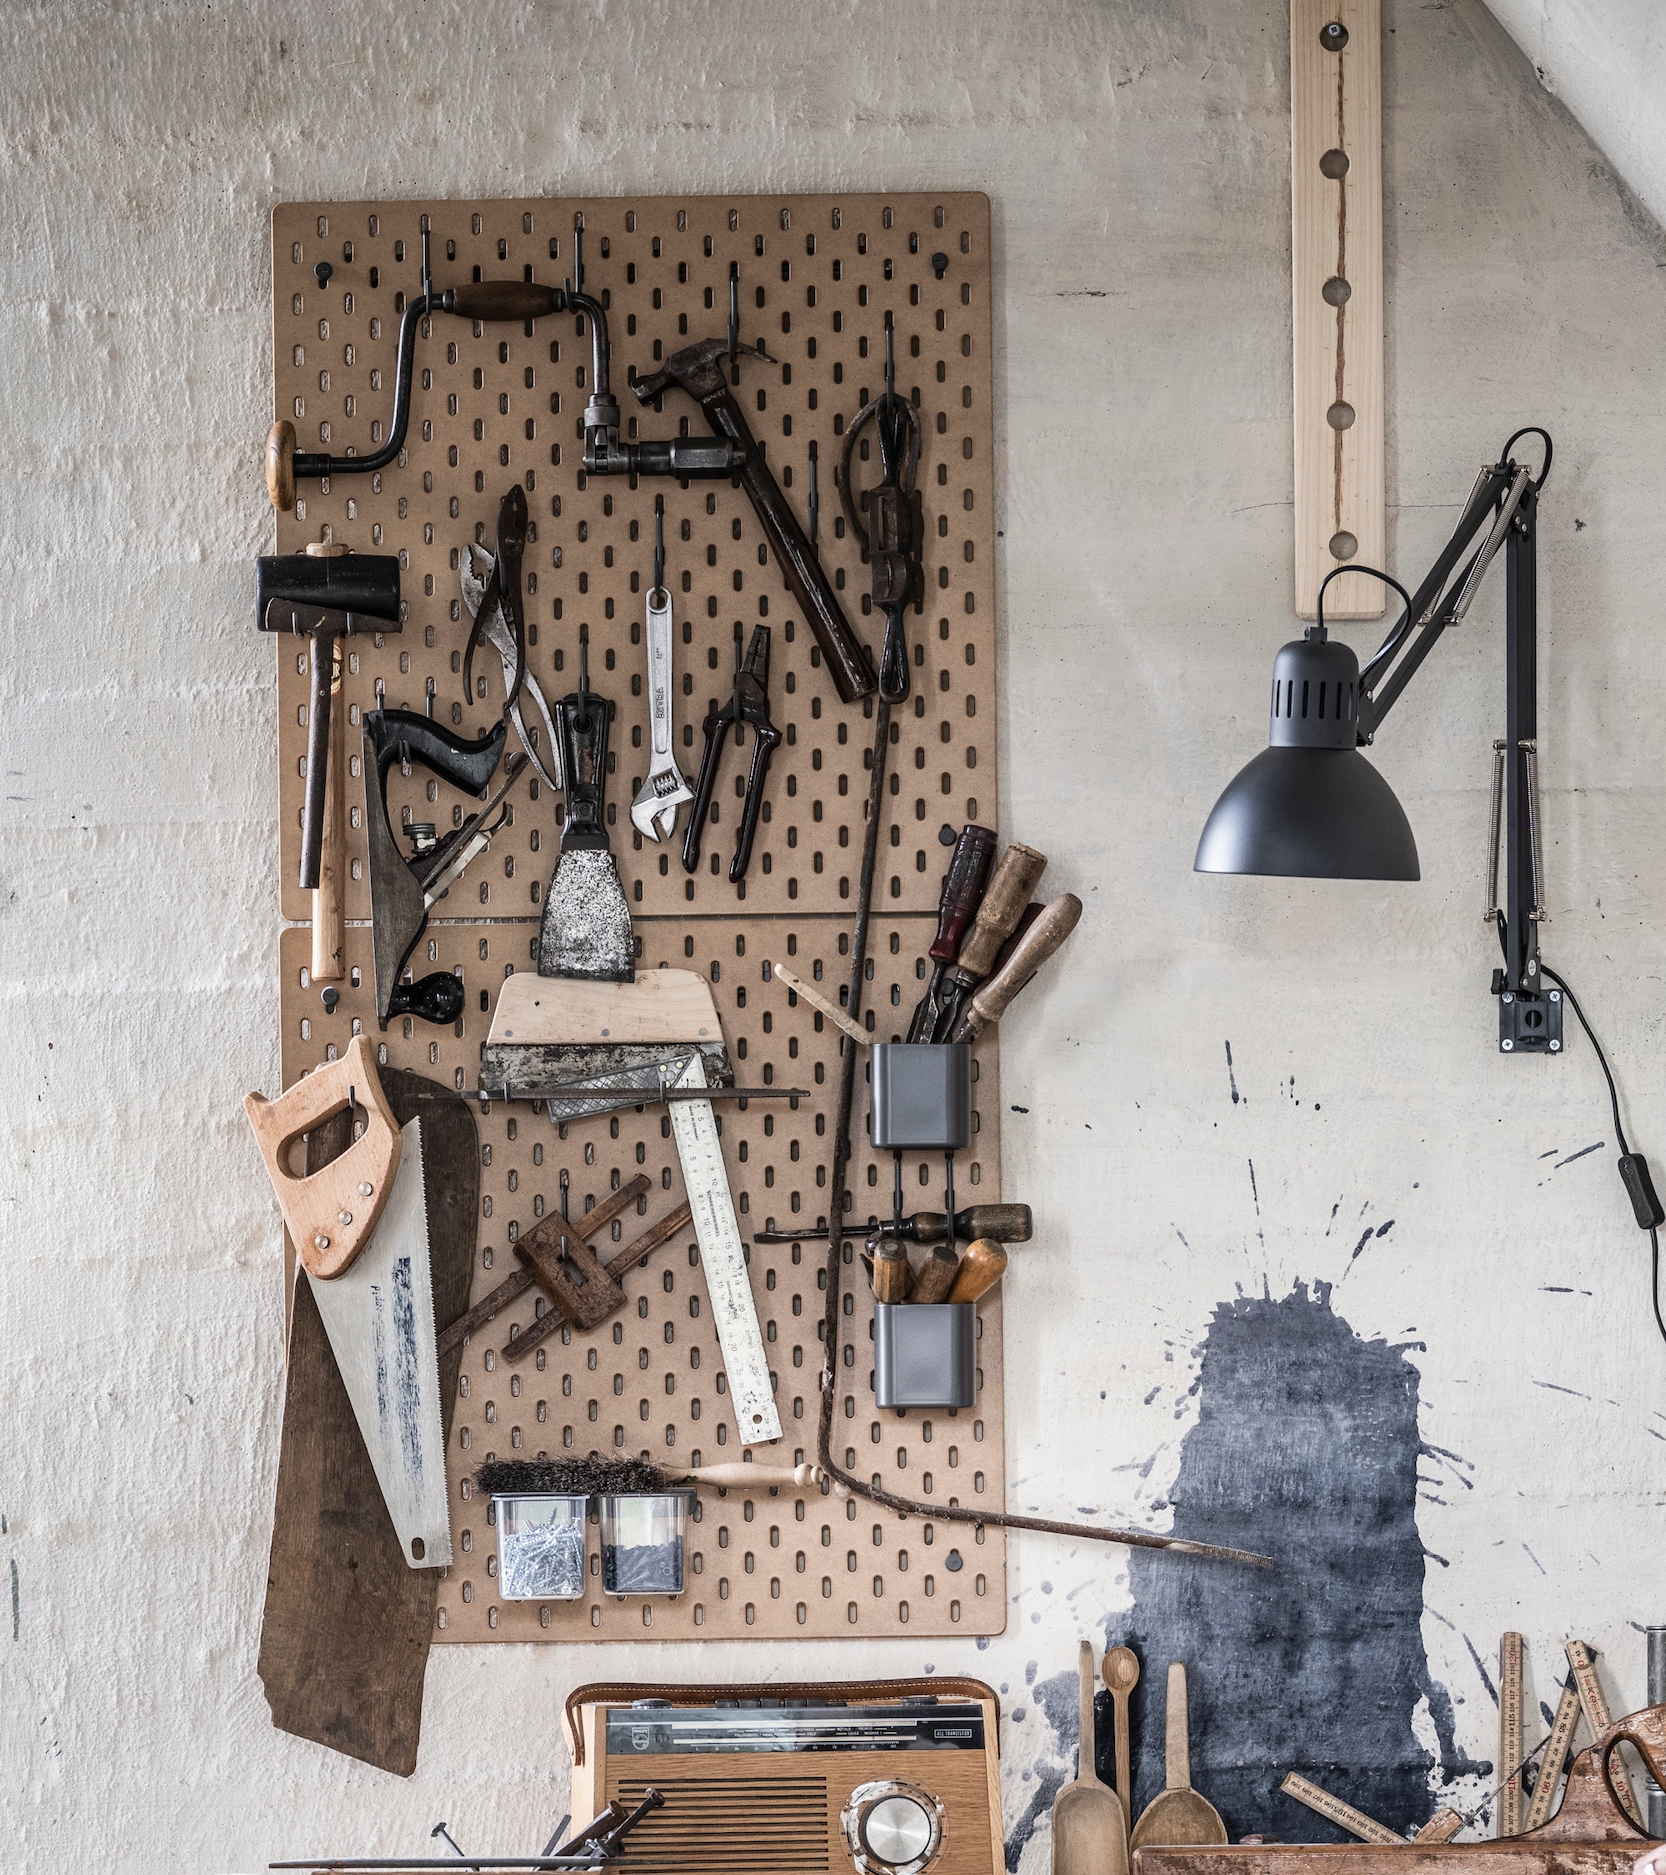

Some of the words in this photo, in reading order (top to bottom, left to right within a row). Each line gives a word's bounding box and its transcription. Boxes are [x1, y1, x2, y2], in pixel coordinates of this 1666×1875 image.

[655, 686, 664, 719] EXTRA
[704, 1217, 710, 1226] 10
[711, 1178, 718, 1186] 10
[738, 1303, 746, 1312] 20
[1509, 1650, 1517, 1666] 120
[1566, 1700, 1573, 1709] 83
[1563, 1712, 1569, 1720] 84
[1559, 1722, 1567, 1733] 85
[1555, 1736, 1562, 1744] 86
[1552, 1747, 1559, 1756] 87
[1541, 1781, 1551, 1794] 90
[1616, 1781, 1625, 1792] 10
[1538, 1795, 1545, 1803] 91
[1535, 1807, 1542, 1815] 92
